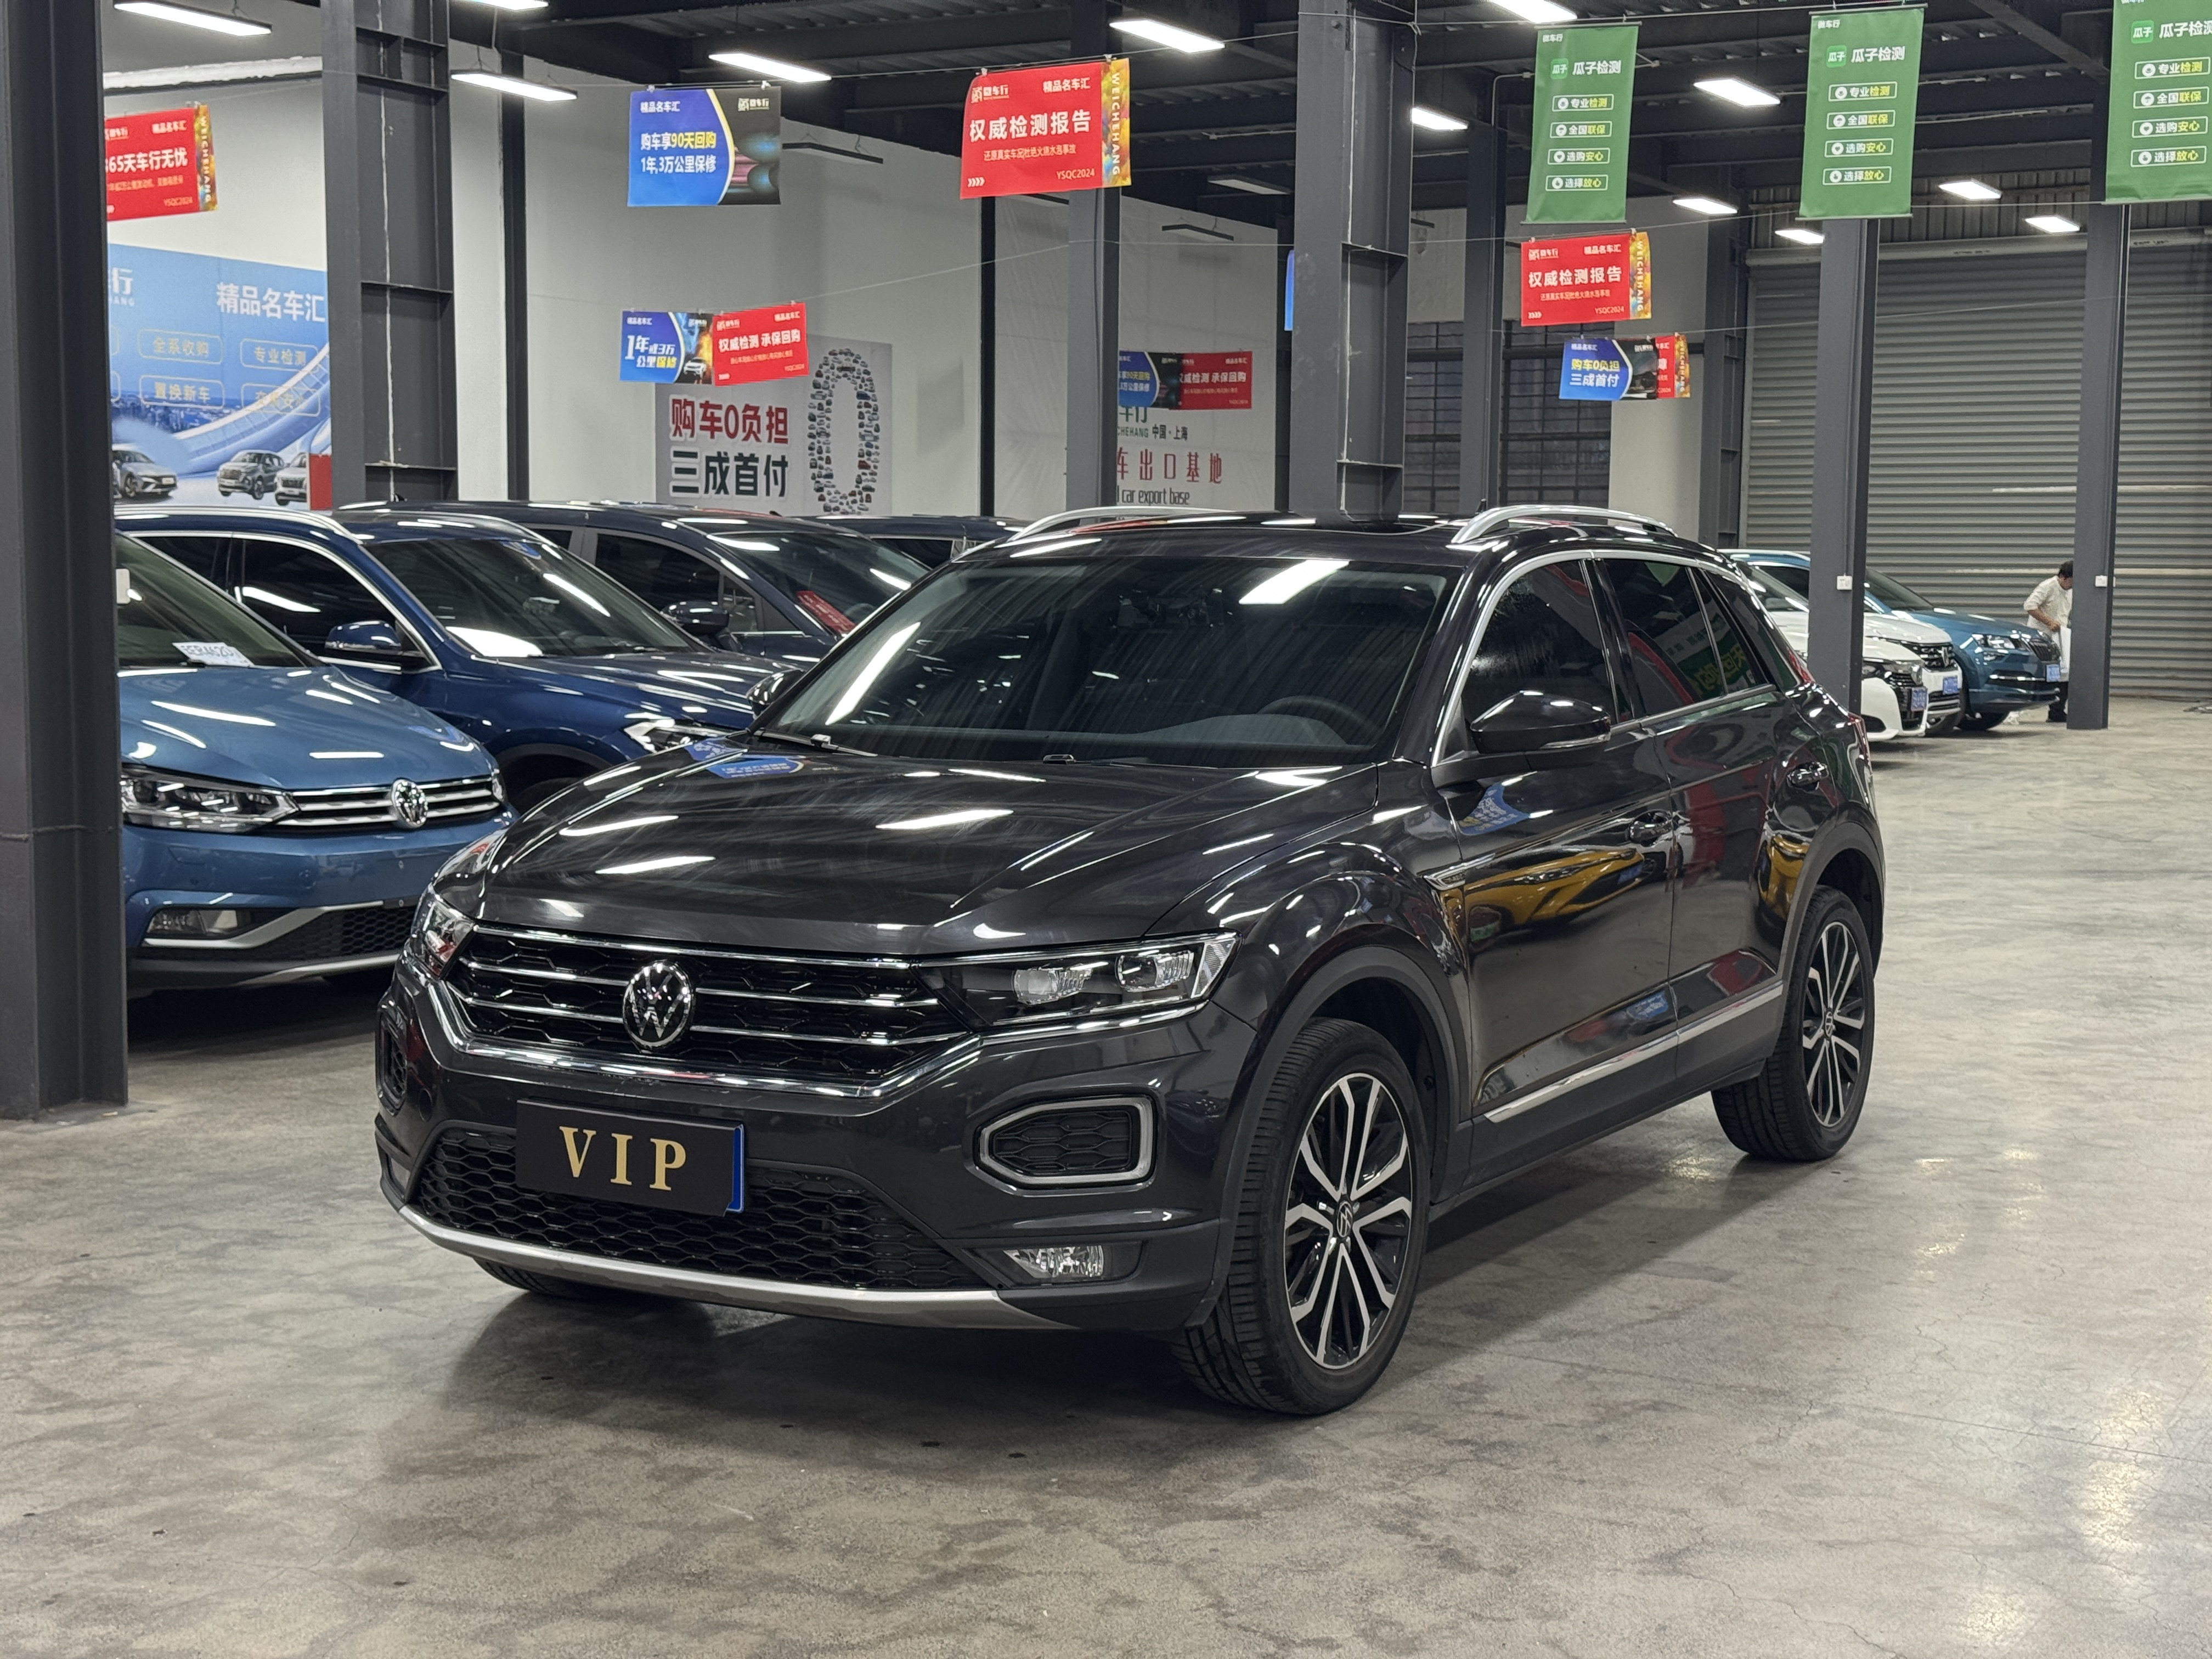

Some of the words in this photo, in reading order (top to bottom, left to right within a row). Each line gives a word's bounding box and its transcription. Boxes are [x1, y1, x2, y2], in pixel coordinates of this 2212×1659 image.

[2132, 26, 2153, 38] 瓜子
[1827, 51, 1846, 63] 瓜子
[1851, 46, 1906, 63] 瓜子检测
[1552, 64, 1568, 75] 瓜子
[1572, 60, 1622, 76] 瓜子检测
[2158, 61, 2203, 75] 专业检测
[1043, 77, 1091, 93] 精品名车汇
[1849, 85, 1891, 98] 专业检测
[1571, 97, 1608, 109] 专业检测
[2157, 91, 2202, 105] 全国联保
[969, 109, 1091, 143] 权威检测报告
[1111, 72, 1121, 176] WEICHEHANG
[1847, 114, 1889, 126] 全国联保
[2155, 120, 2200, 134] 选购安心
[1568, 124, 1606, 136] 全国联保
[640, 131, 717, 150] 购车享90天回购
[1846, 142, 1887, 153] 选购安心
[1566, 151, 1604, 162] 选购安心
[2154, 150, 2199, 163] 选择放心
[1056, 168, 1095, 180] YSQC2024
[1843, 170, 1884, 182] 选择放心
[1565, 178, 1602, 189] 选择放心
[1528, 265, 1622, 288] 权威检测报告
[217, 281, 326, 323] 精品名车汇
[718, 334, 760, 353] 权威检测
[153, 336, 210, 358] 全系收购
[254, 346, 307, 366] 专业检测
[1570, 373, 1620, 387] 三成首付
[154, 382, 211, 402] 置换新车
[672, 398, 789, 444] 购车0负担
[672, 451, 789, 497] 三成首付
[1121, 489, 1136, 504] car
[1138, 488, 1167, 506] export
[1169, 487, 1190, 505] base
[558, 1125, 686, 1192] VIP
